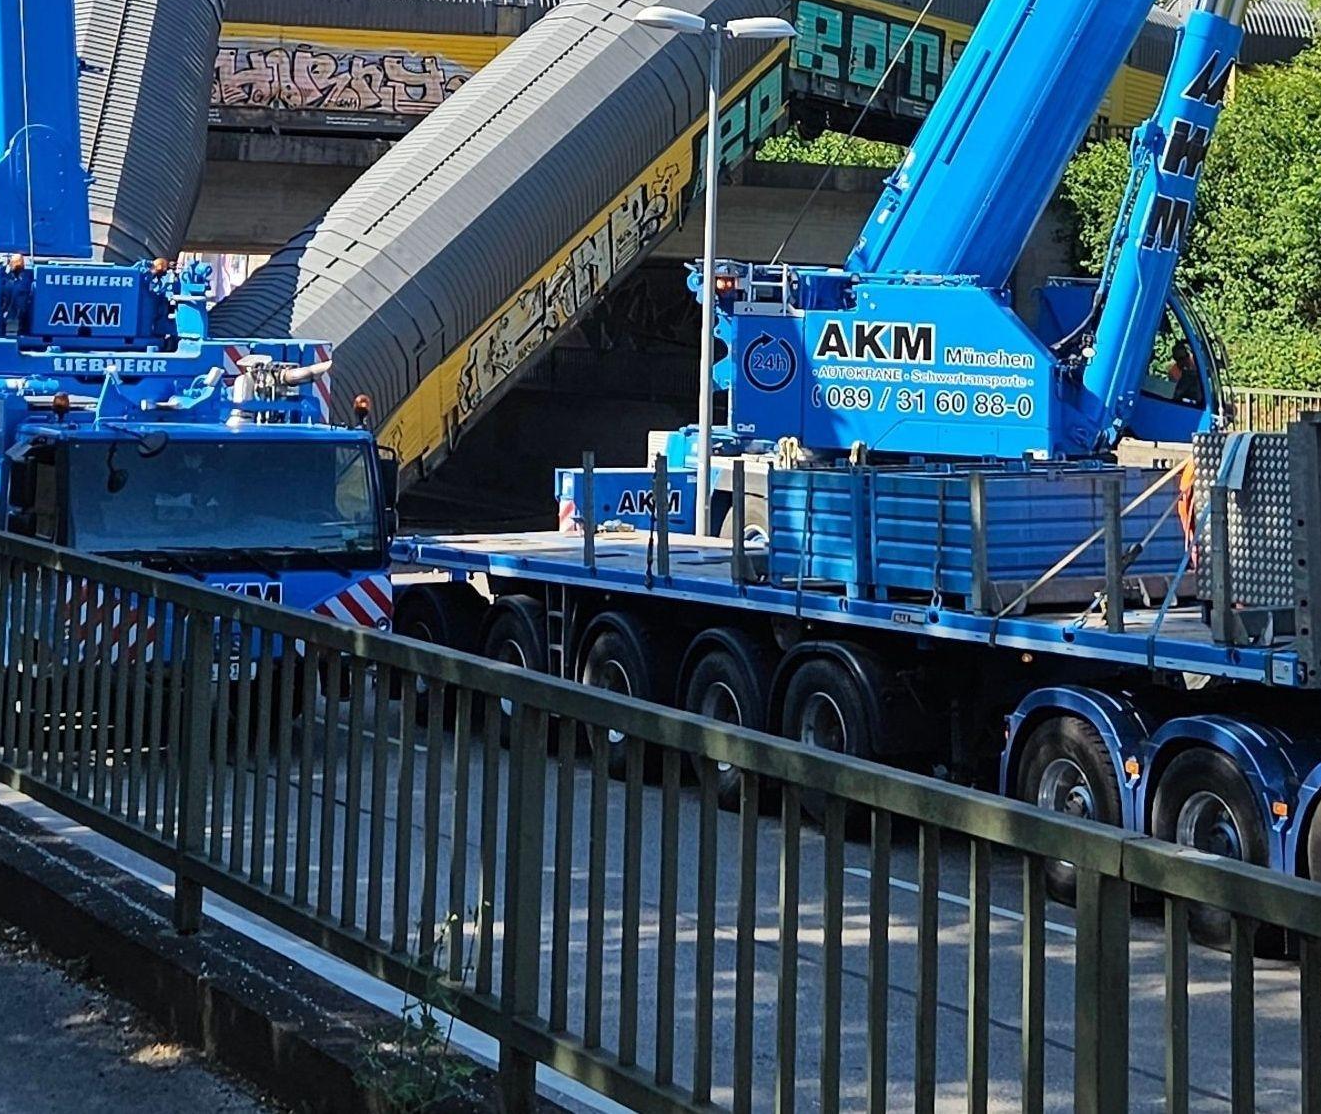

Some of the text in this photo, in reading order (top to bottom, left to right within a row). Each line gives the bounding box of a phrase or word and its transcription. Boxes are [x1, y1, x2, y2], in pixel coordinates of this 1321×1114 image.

[45, 273, 134, 287] LIEBHERR
[49, 302, 122, 327] AKM
[813, 320, 1035, 369] AKM München
[53, 357, 167, 372] LIEBHERR
[752, 352, 789, 371] 24h
[819, 367, 1026, 388] AUTOKRANE Schwertransporte
[825, 387, 1034, 417] 089 / 31 60 88-0
